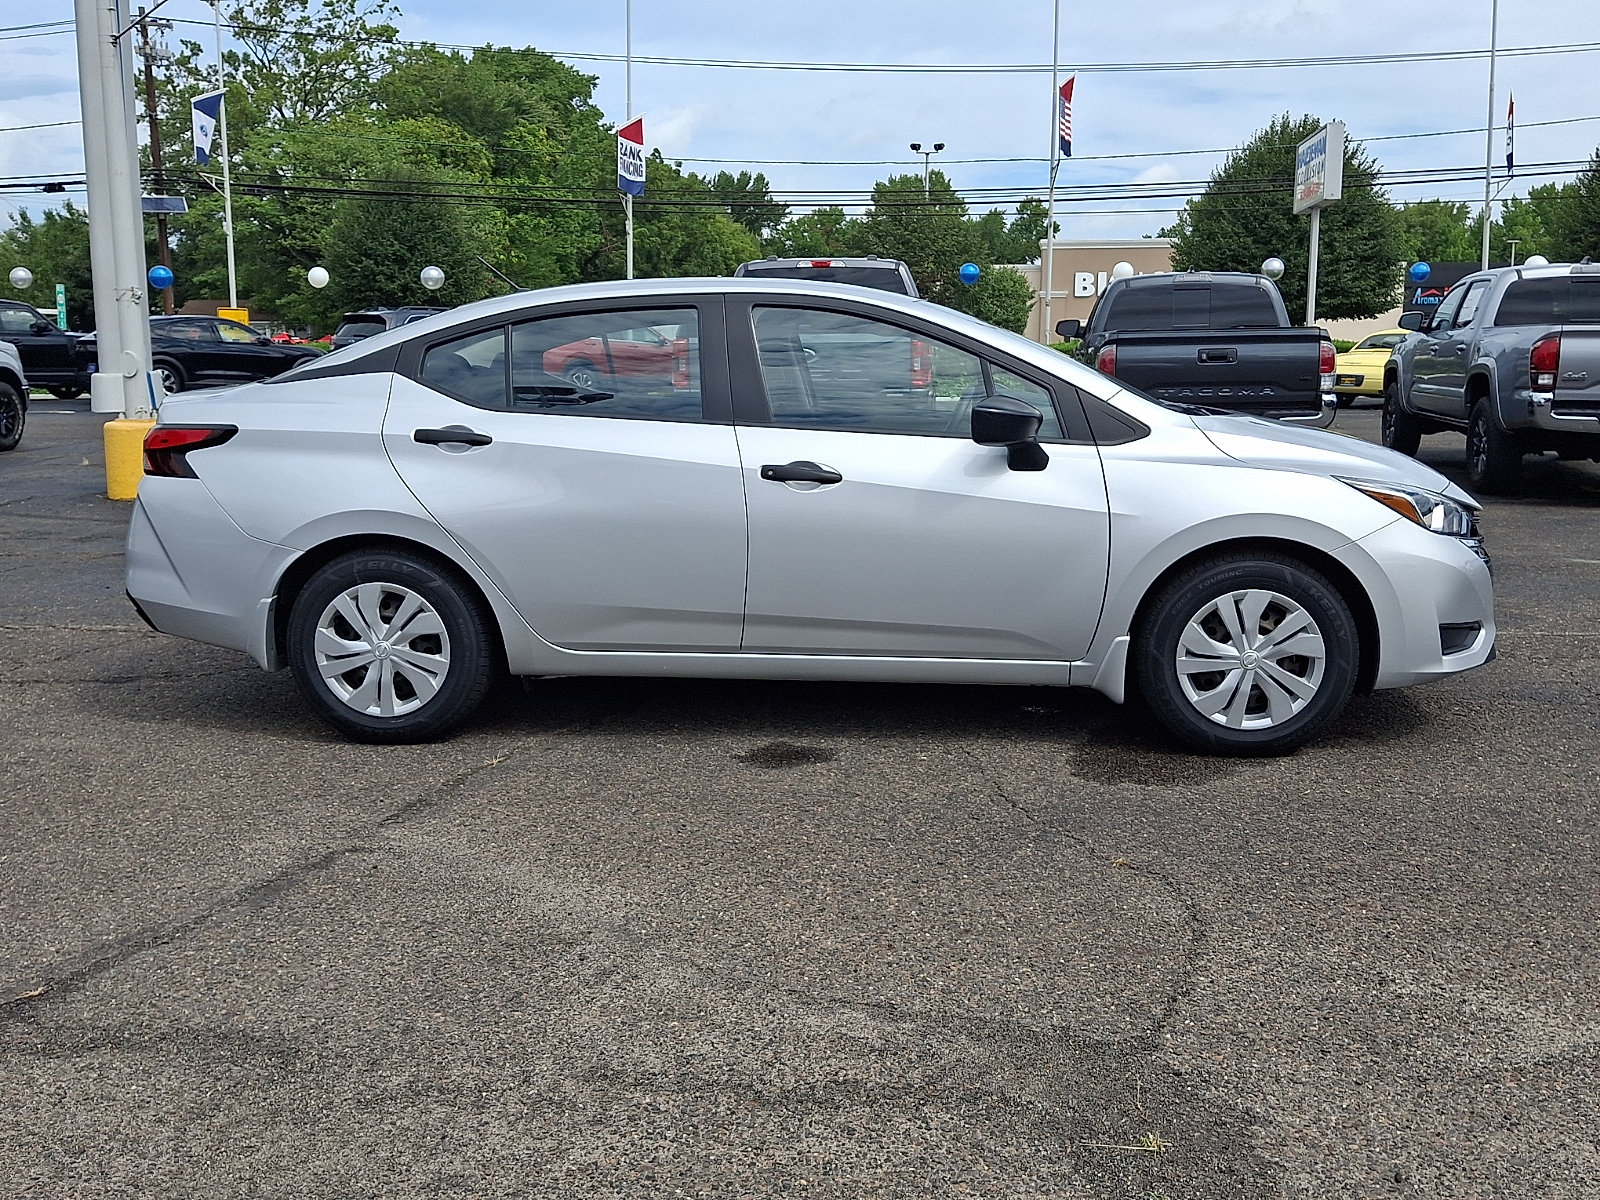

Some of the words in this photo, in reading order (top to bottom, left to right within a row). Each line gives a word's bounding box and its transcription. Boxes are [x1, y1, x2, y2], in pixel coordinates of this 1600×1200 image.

[1158, 387, 1275, 396] TACOMA
[1198, 569, 1243, 590] TOURING
[1308, 586, 1348, 640] KELLY
